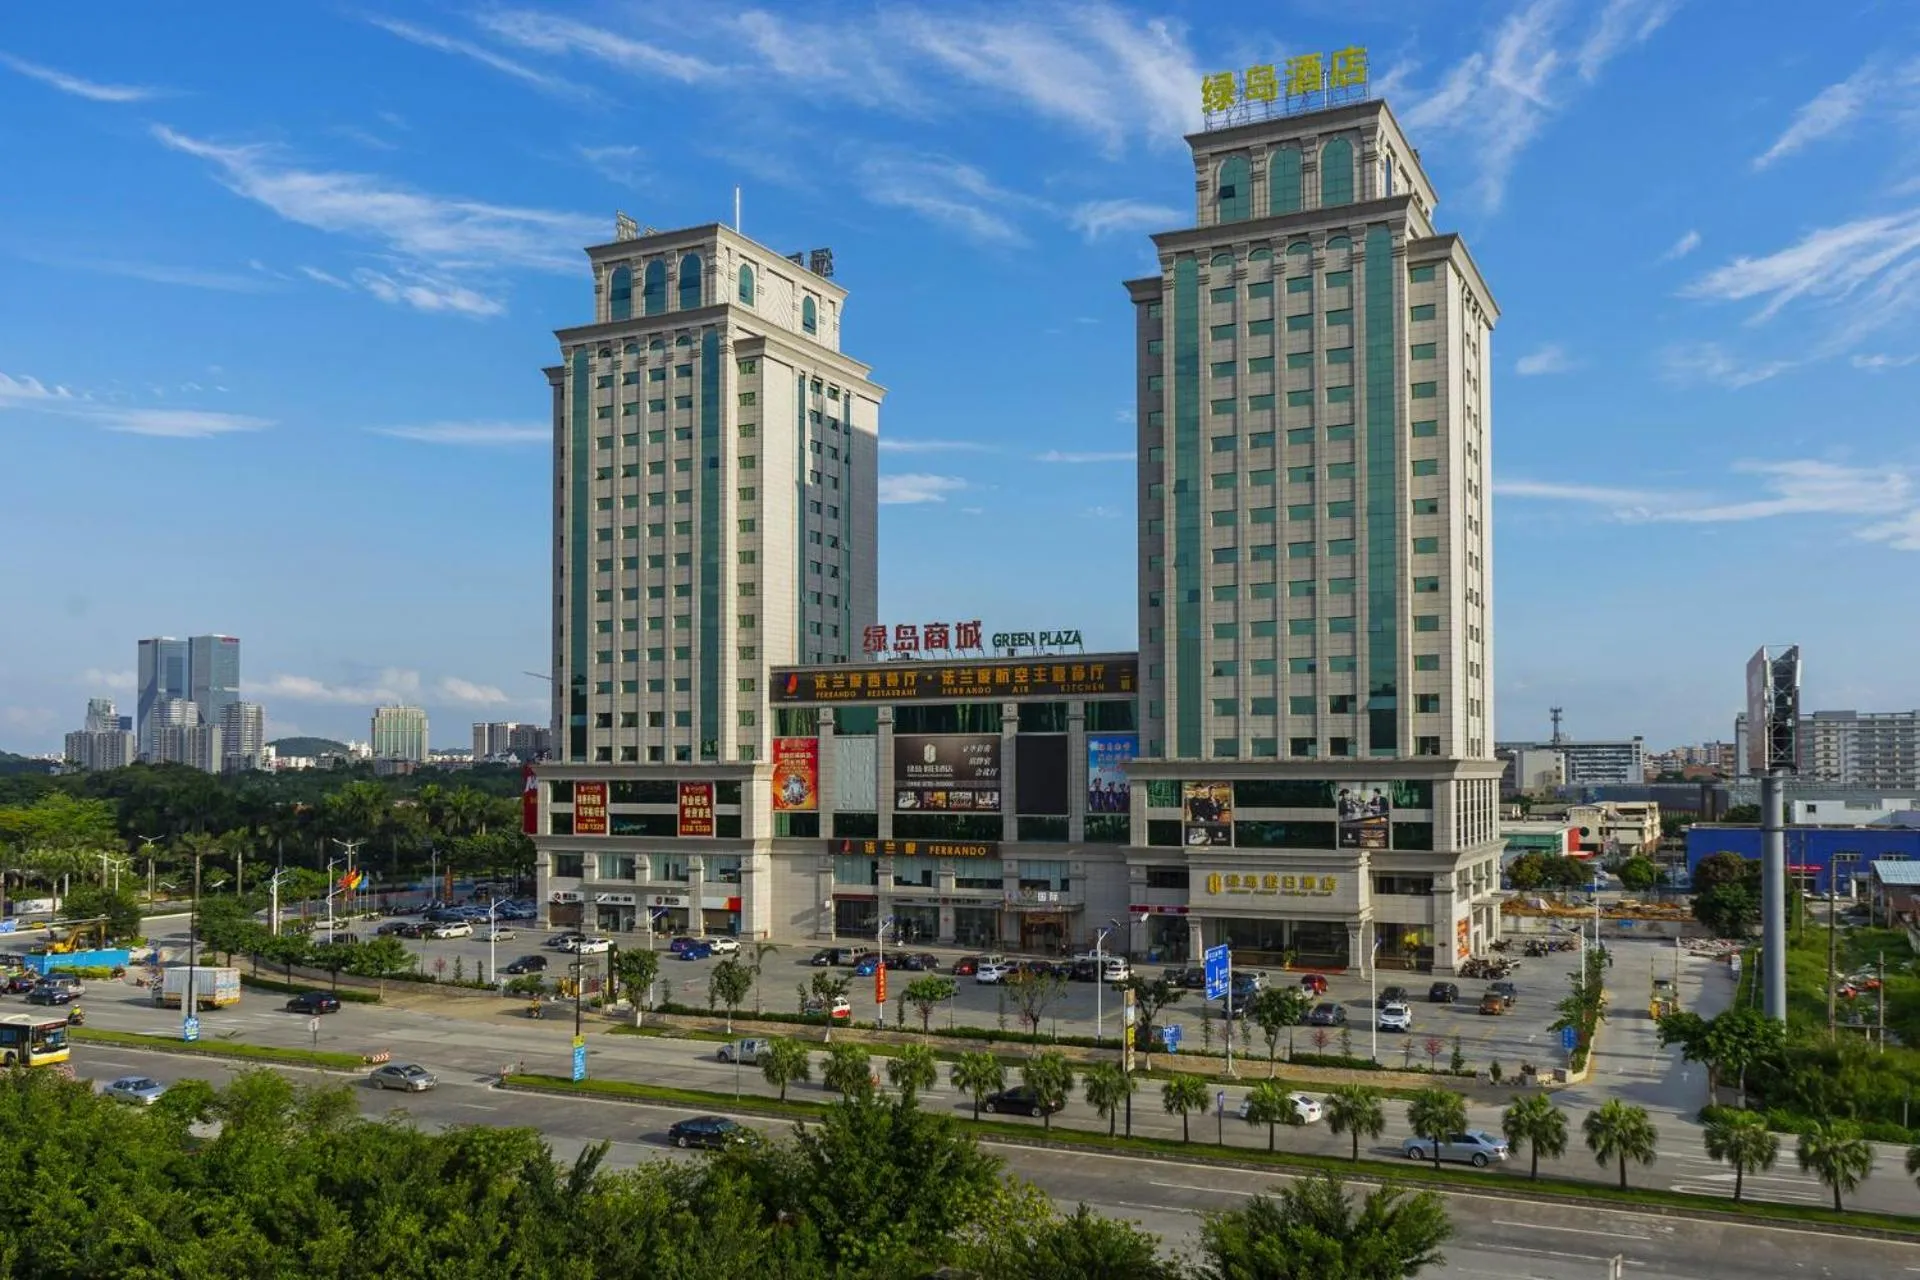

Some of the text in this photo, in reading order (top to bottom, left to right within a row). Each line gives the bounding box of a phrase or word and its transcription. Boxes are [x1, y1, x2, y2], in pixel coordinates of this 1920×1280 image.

[1202, 46, 1367, 113] 绿岛酒店
[864, 620, 982, 650] 绿岛商城
[992, 630, 1082, 647] GREEN PLAZA
[929, 845, 986, 856] FERRANDO
[1038, 892, 1057, 901] 国际
